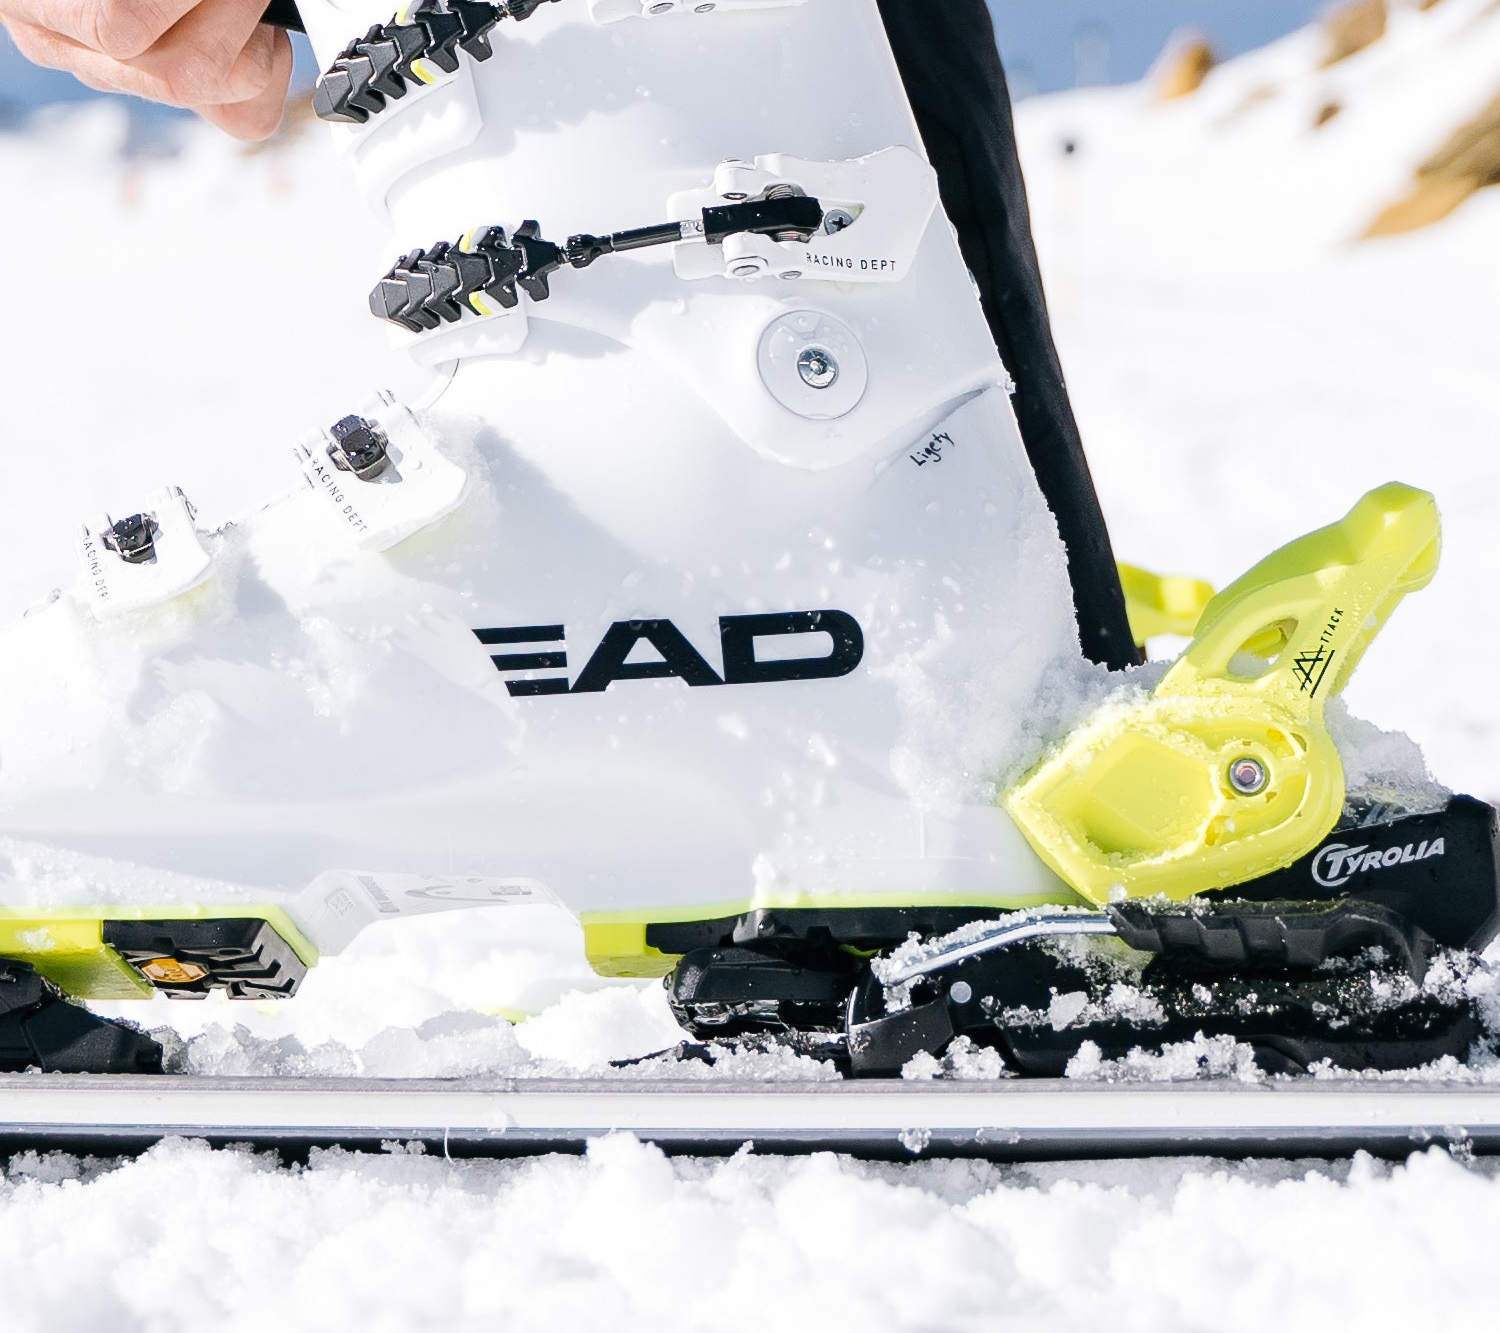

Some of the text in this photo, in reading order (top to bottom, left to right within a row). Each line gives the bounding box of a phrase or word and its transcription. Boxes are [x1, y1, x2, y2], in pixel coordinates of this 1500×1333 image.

[806, 252, 897, 272] RACING DEPT
[909, 431, 956, 467] Ligety
[311, 457, 369, 533] RACING DEPT
[1313, 837, 1446, 886] TYROLIA
